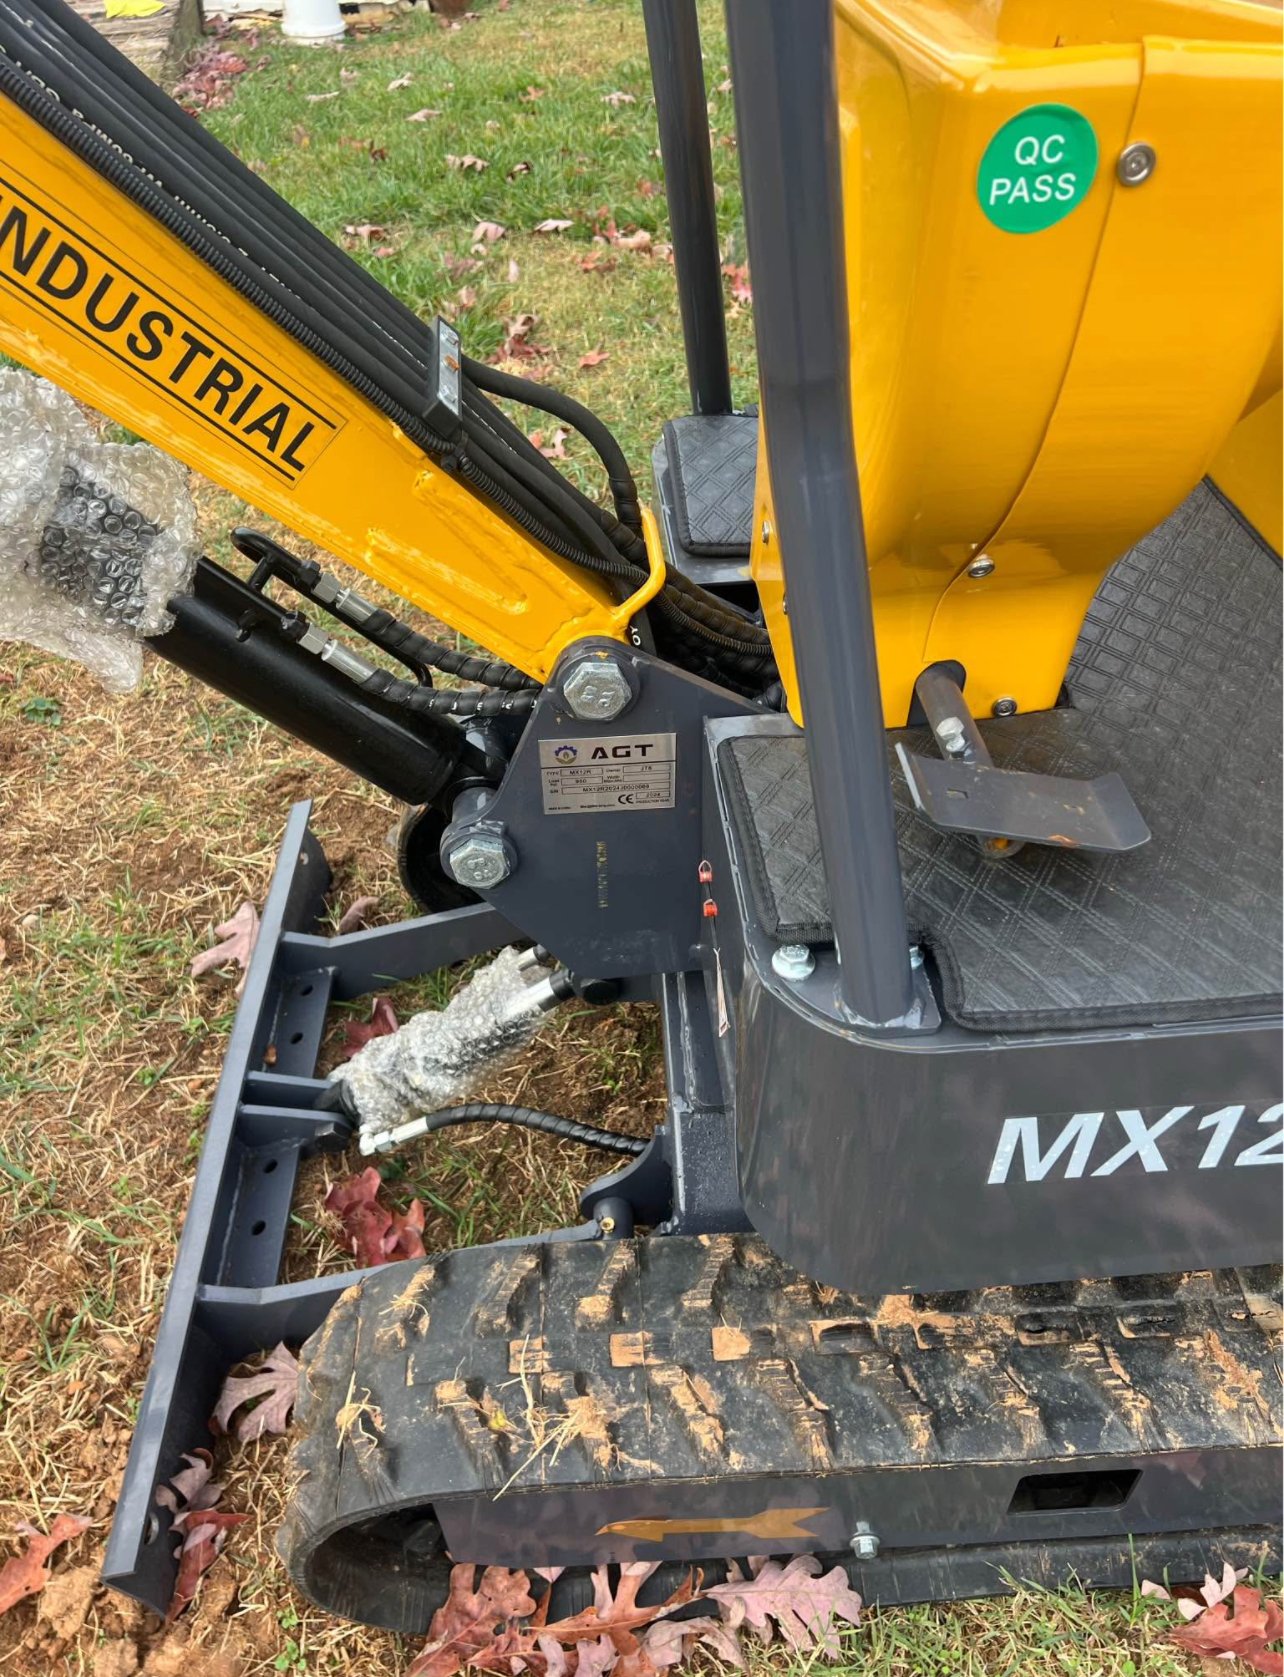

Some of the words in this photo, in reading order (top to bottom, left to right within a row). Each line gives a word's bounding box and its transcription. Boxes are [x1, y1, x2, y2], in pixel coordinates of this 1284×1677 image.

[1014, 134, 1065, 165] QC
[989, 172, 1077, 206] PASS
[0, 194, 315, 472] NDUSTRIAL
[591, 744, 654, 760] AGT
[618, 793, 634, 805] CE
